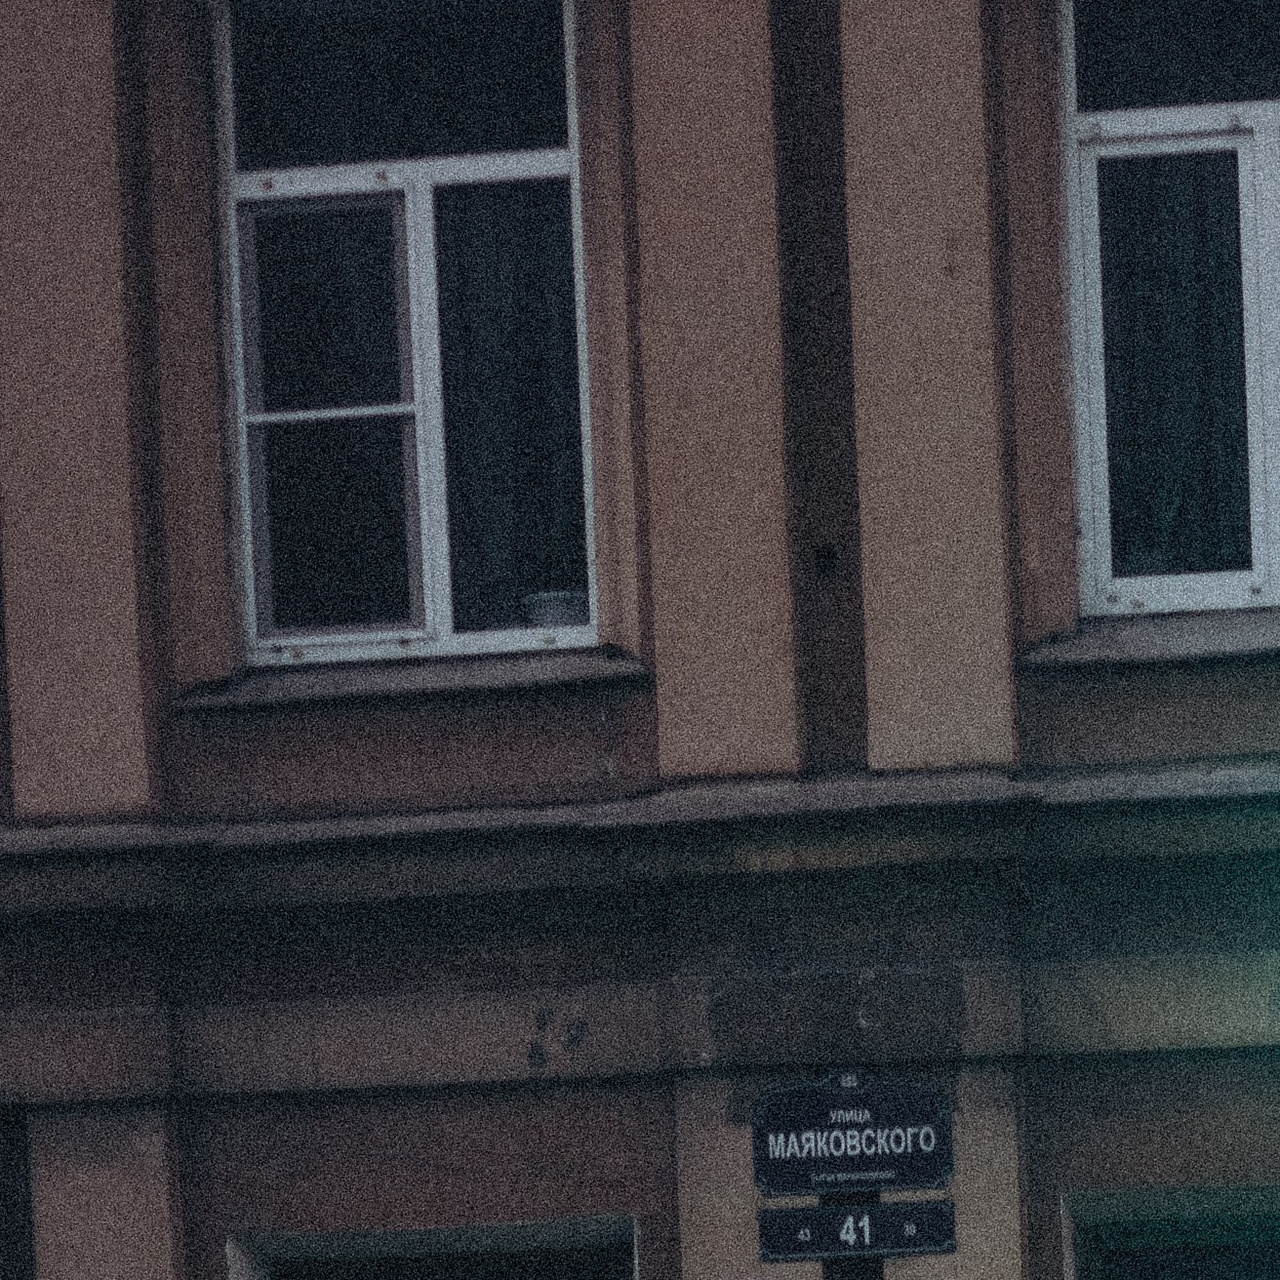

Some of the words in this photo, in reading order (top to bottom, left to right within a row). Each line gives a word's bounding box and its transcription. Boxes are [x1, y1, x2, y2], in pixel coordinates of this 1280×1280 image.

[829, 1109, 871, 1125] УЛИЦА
[767, 1125, 937, 1160] МАЯКОВСКОГО
[839, 1214, 871, 1246] 41
